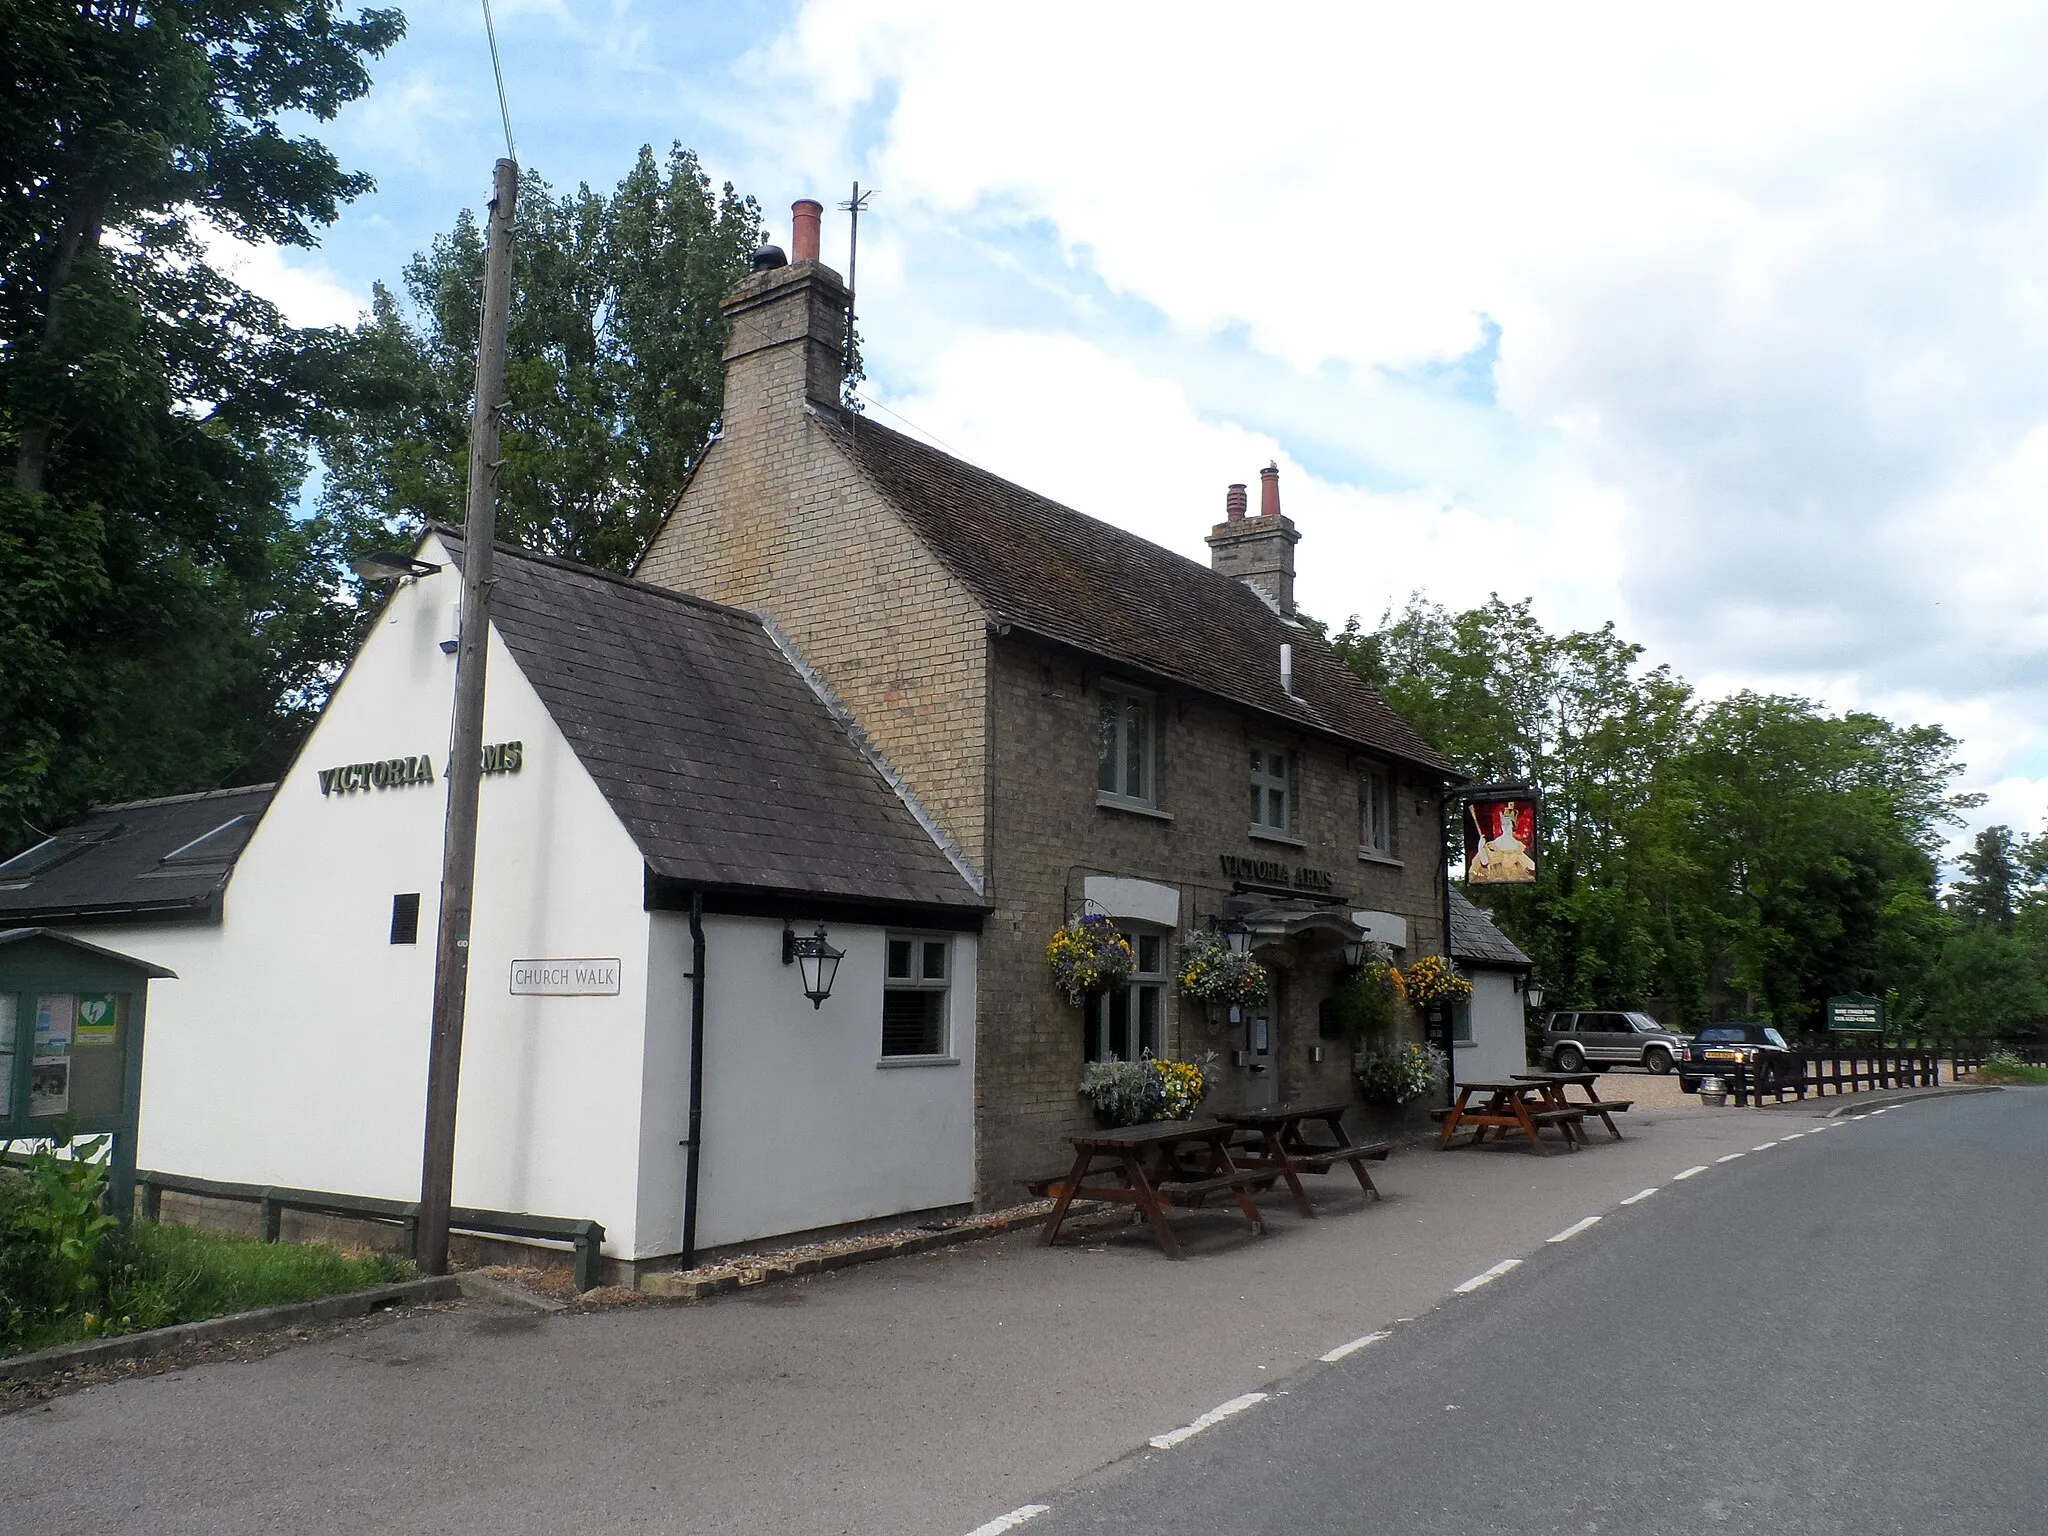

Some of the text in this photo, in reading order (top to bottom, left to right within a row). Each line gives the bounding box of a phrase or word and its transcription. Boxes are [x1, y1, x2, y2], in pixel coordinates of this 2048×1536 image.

[317, 740, 523, 796] VICTORIA MS
[1220, 854, 1332, 888] VICTORIA ARMS
[515, 967, 614, 985] CHURCH WALK
